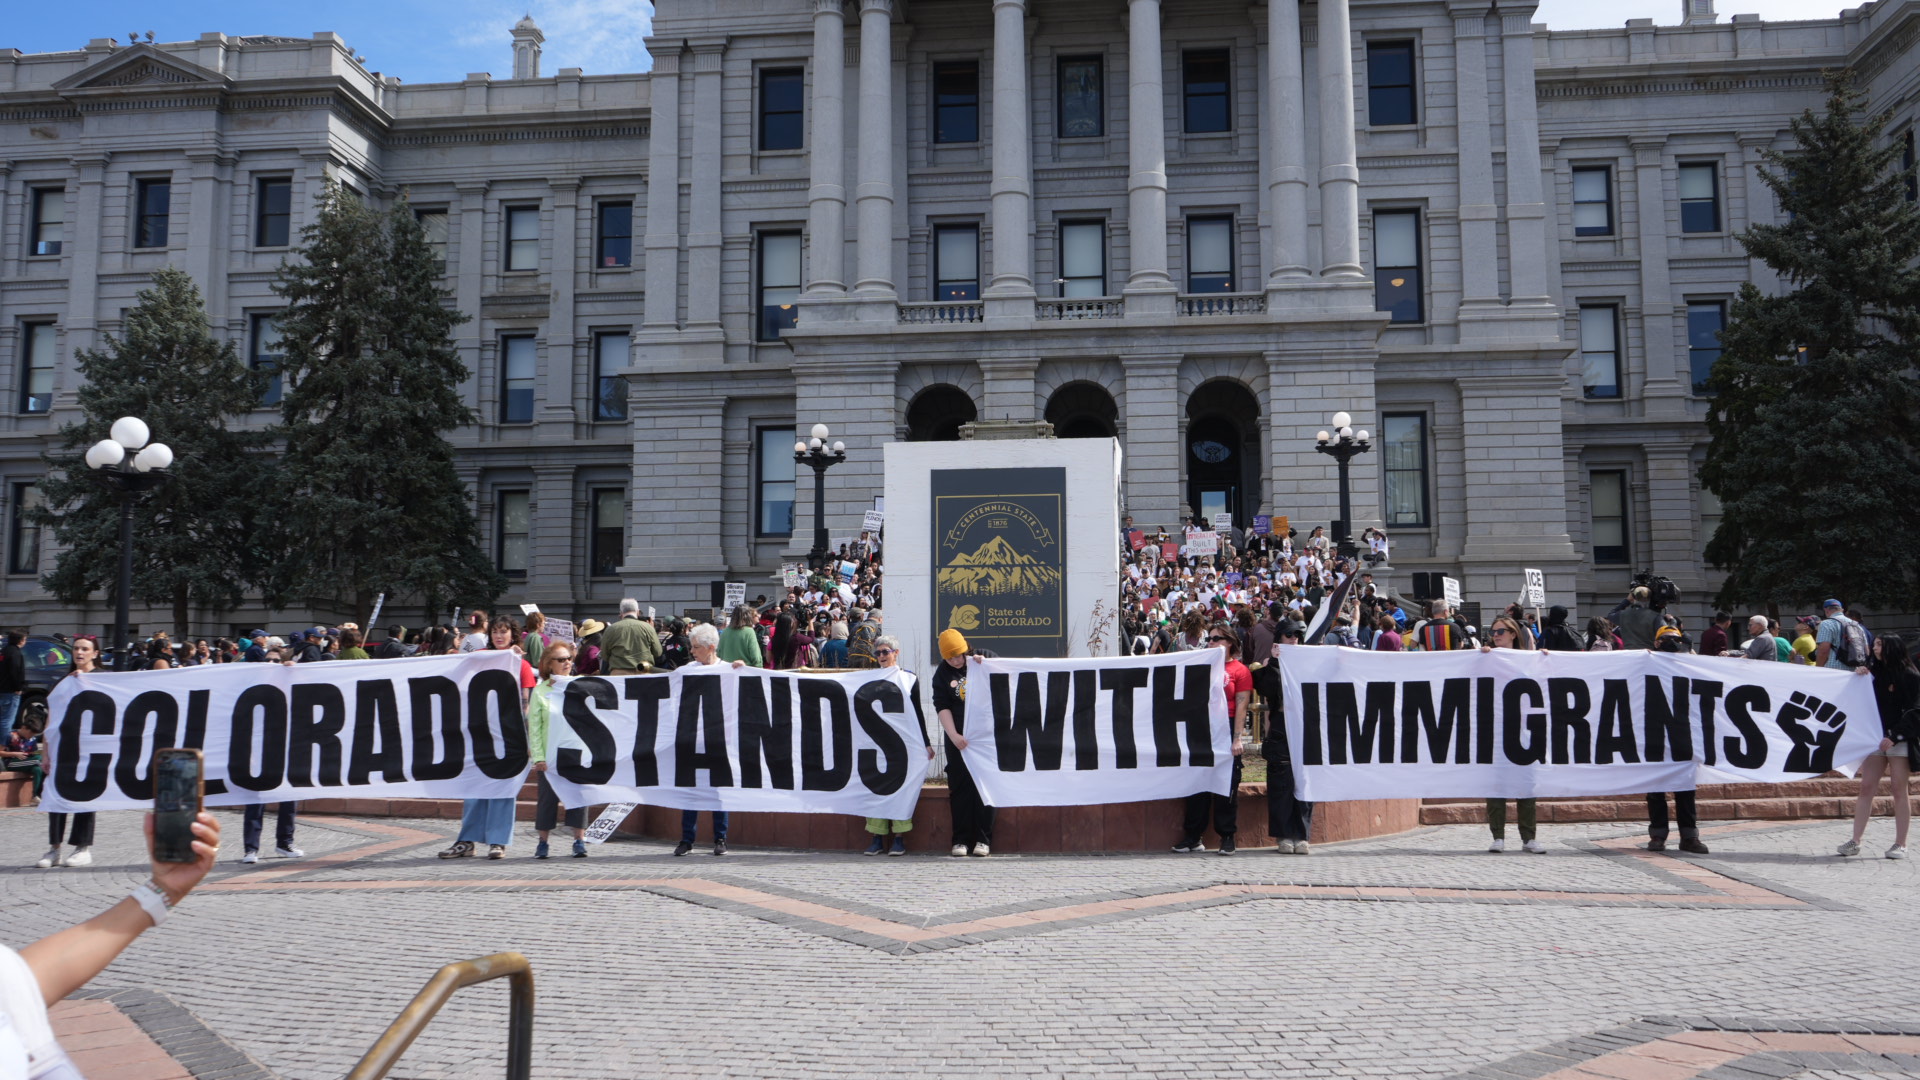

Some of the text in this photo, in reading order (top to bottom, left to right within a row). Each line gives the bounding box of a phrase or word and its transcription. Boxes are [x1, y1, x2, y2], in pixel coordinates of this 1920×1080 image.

[960, 504, 1038, 528] CENTENNIAL STATE
[1192, 539, 1211, 547] BUILT
[1527, 571, 1542, 587] ICE
[1528, 589, 1544, 599] FUERA
[988, 607, 1027, 616] State of
[988, 617, 1052, 627] COLORADO
[54, 663, 1771, 802] COLORADO STANDS WITH IMMIGRANTS
